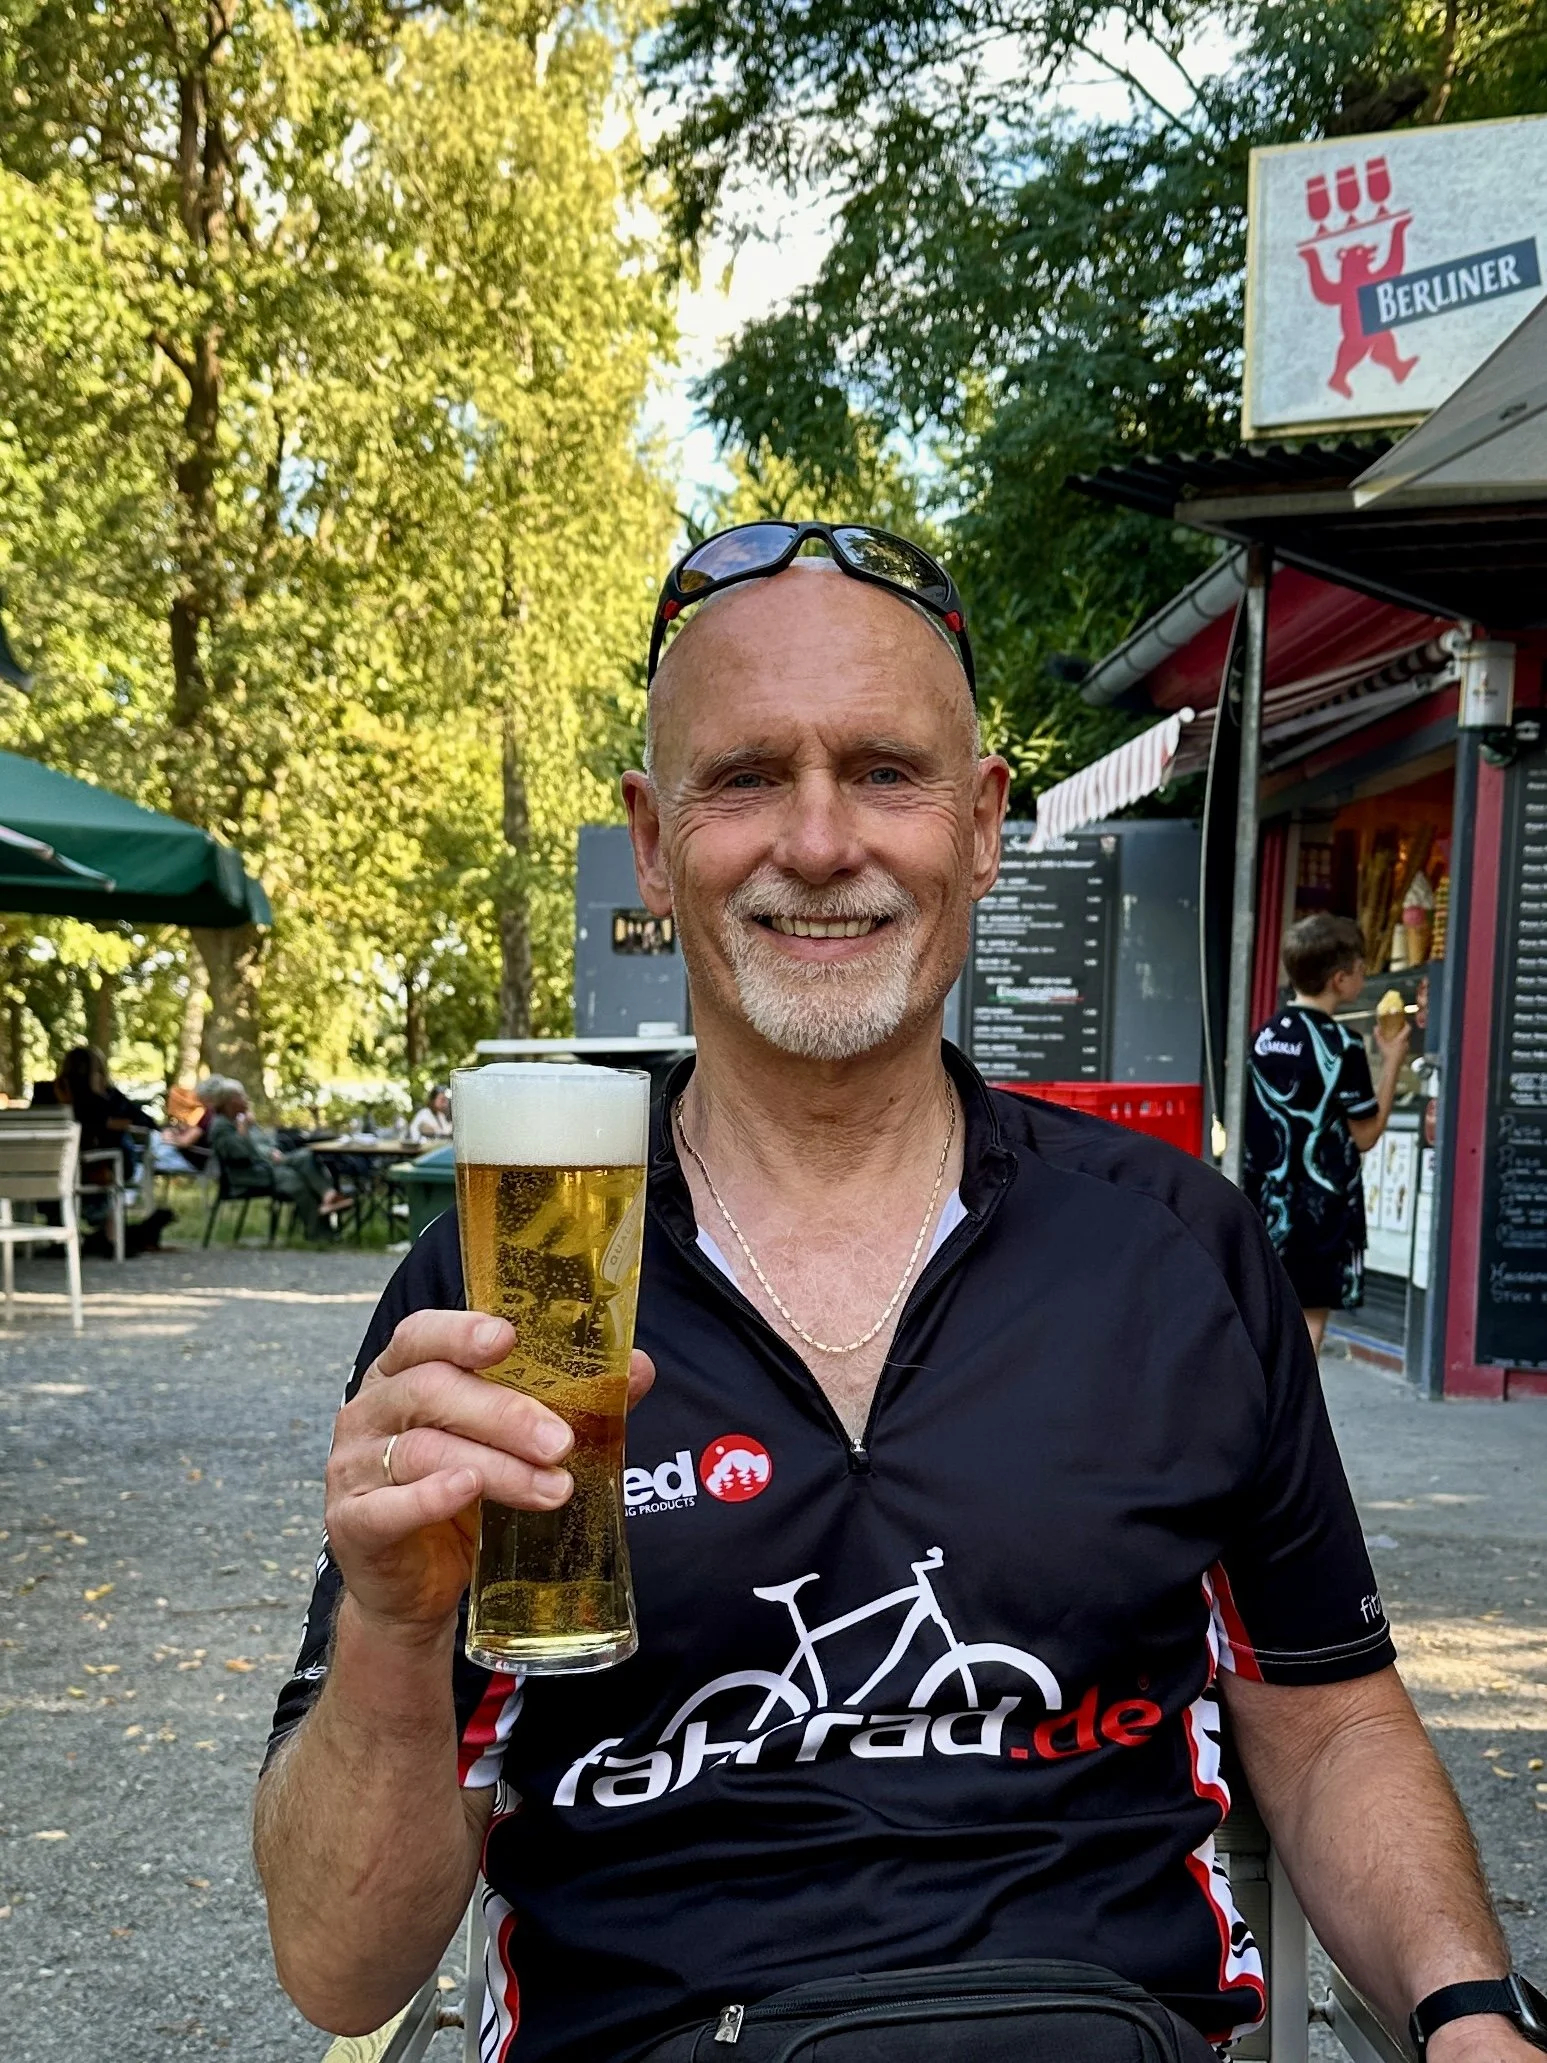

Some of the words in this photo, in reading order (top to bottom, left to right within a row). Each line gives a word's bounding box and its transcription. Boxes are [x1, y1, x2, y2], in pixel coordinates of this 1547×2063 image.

[1376, 254, 1521, 323] BERLINER
[639, 1497, 695, 1514] PRODUCTS
[552, 1685, 1163, 1807] fahrrad.de
